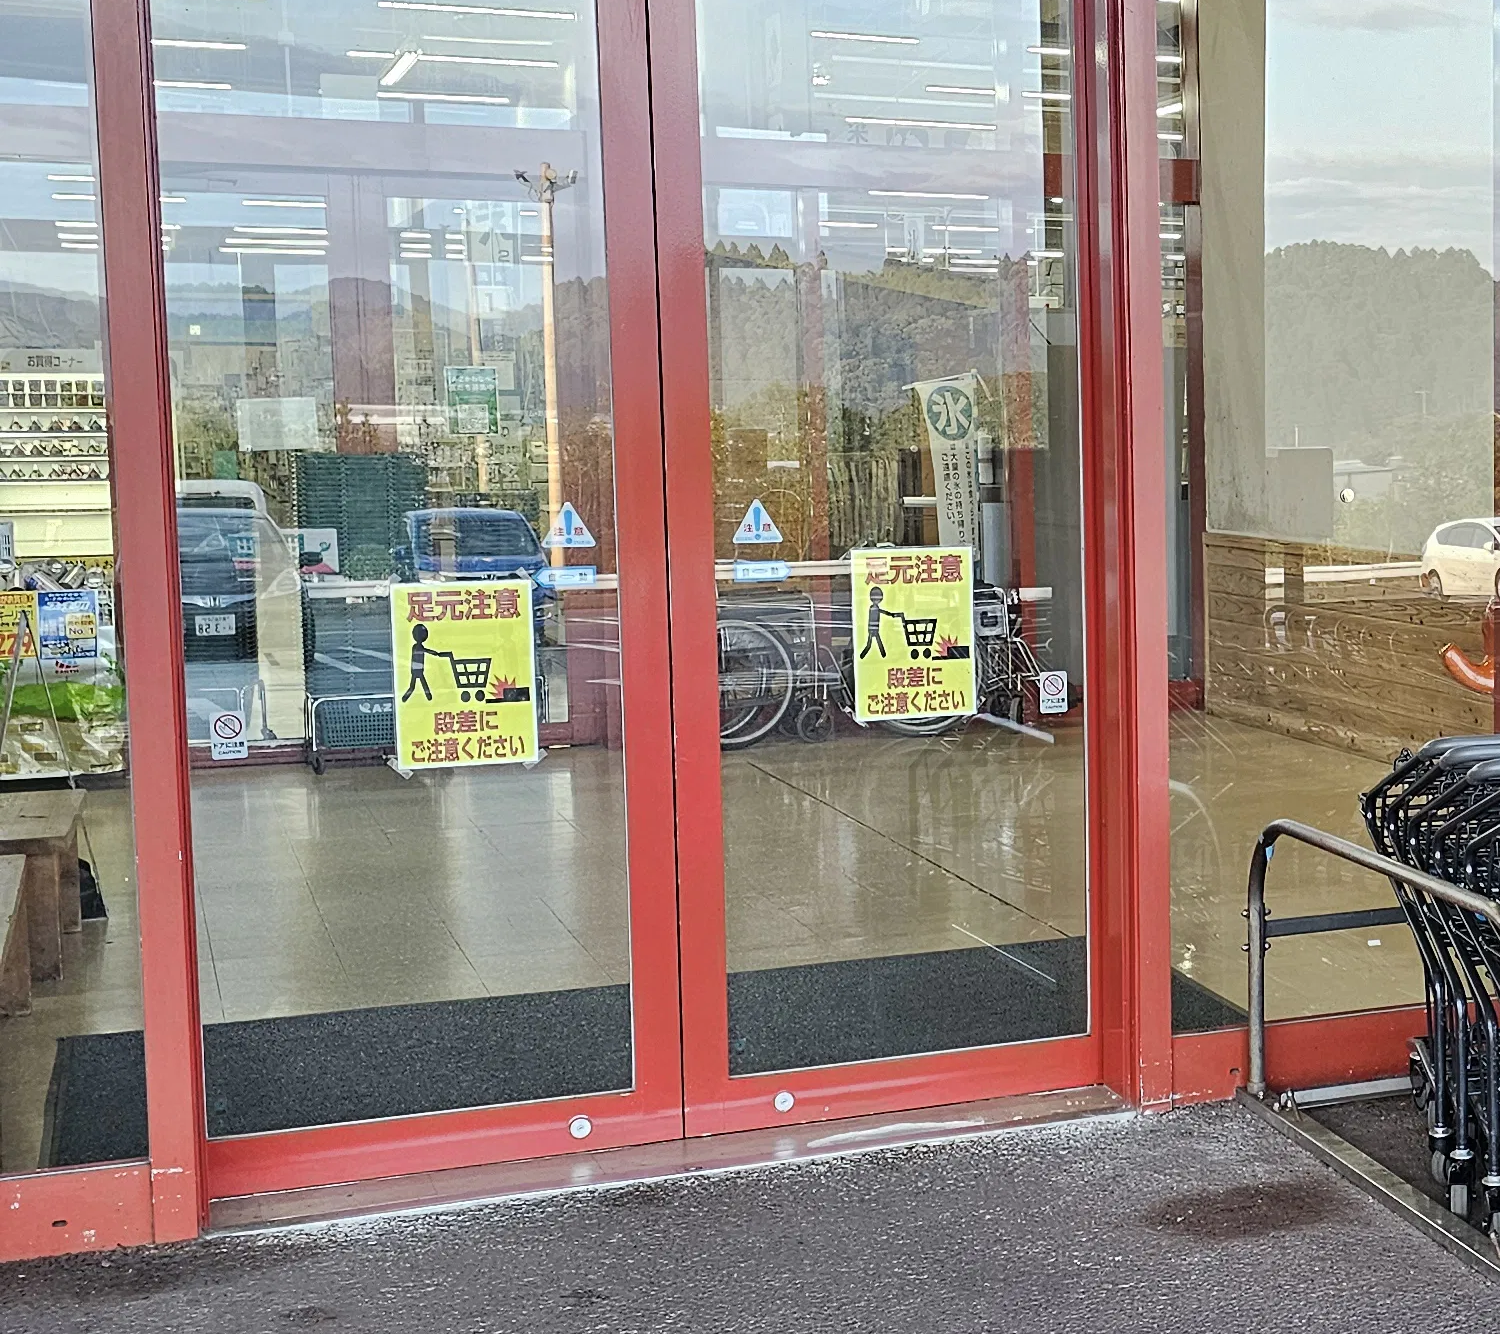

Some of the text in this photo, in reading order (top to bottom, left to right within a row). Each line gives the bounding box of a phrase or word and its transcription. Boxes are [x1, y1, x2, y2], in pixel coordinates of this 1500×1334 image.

[931, 390, 970, 435] 氷
[865, 554, 964, 585] 足元注意
[406, 587, 521, 623] 足元注意
[887, 667, 943, 689] 段差に
[867, 690, 966, 715] ご注意ください
[433, 710, 499, 735] 段差に
[212, 741, 245, 749] ドアに注意
[411, 735, 526, 764] ご注意ください
